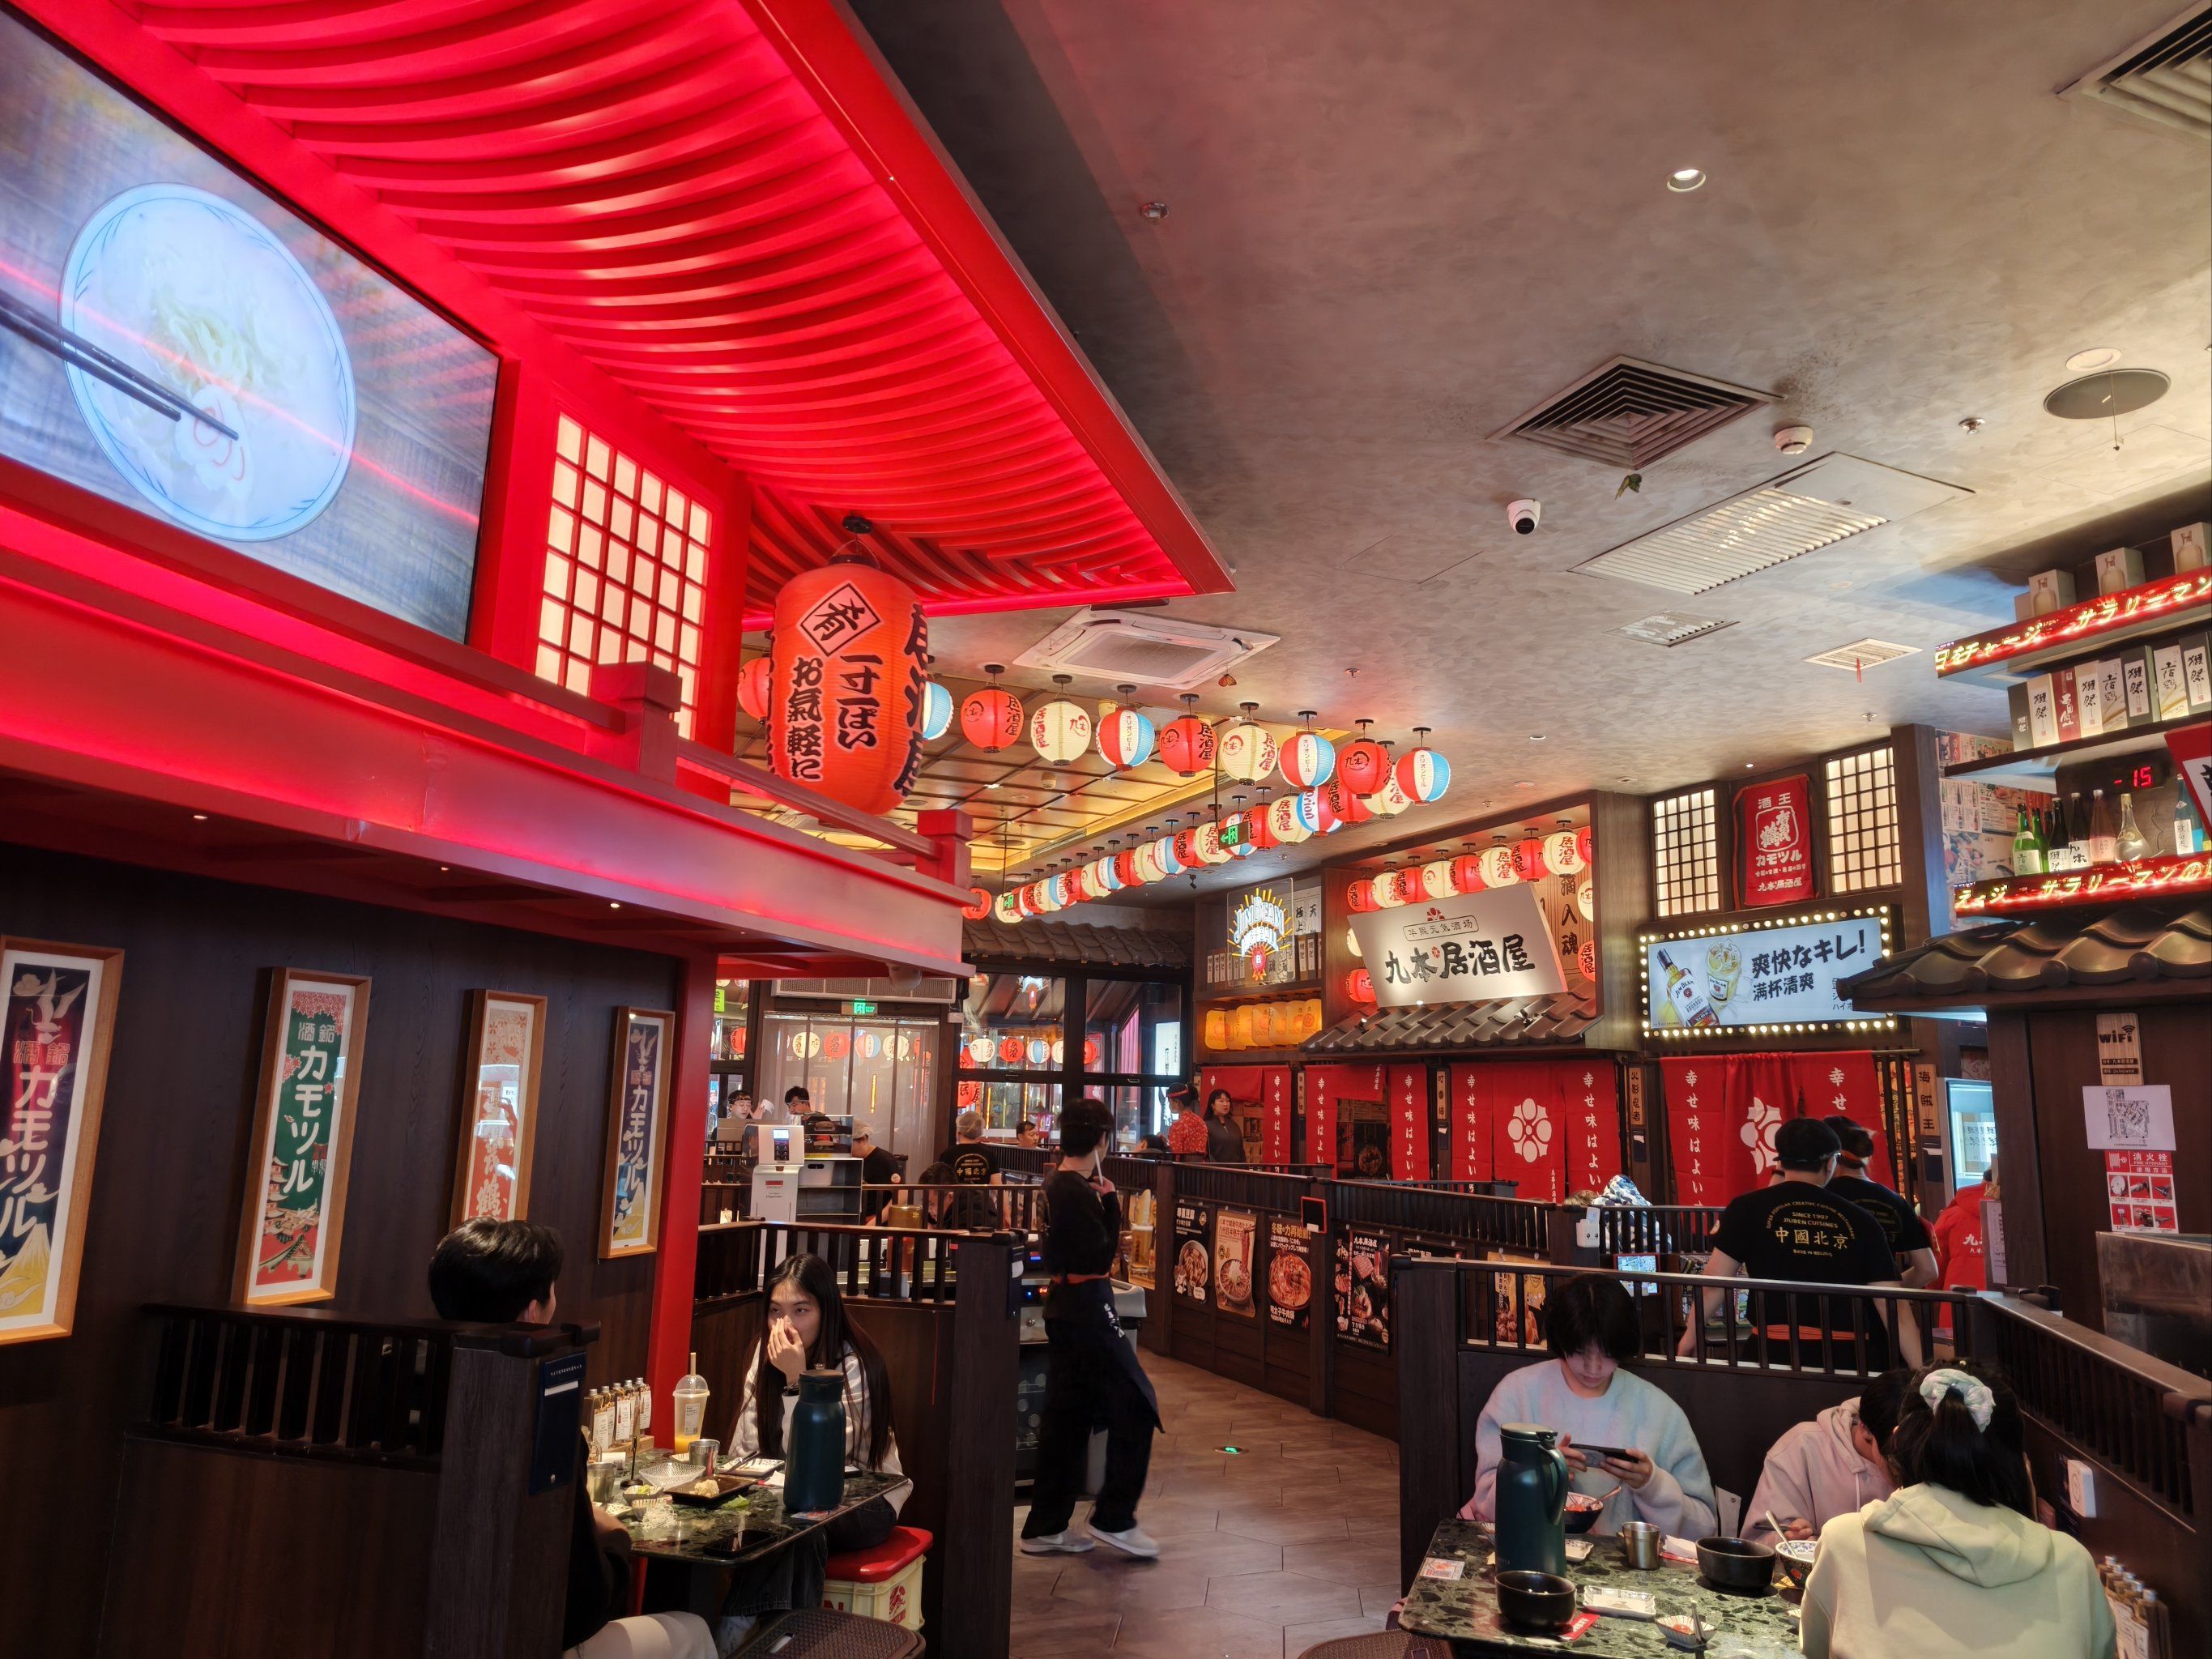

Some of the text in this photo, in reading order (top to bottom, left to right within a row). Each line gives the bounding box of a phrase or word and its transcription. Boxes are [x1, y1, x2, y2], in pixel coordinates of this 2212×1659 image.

[1259, 732, 1276, 770] 居酒屋
[1276, 800, 1294, 832] 居酒屋
[1558, 836, 1575, 865] 居酒屋
[1756, 849, 1802, 867] カモツル
[2042, 860, 2212, 899] サラリーマンの
[1384, 932, 1536, 987] 九本居酒屋
[1631, 1071, 1641, 1122] 火影忍者
[283, 1045, 328, 1193] カモツル
[624, 1085, 649, 1191] カモツル
[1685, 1069, 1704, 1206] 幸せ味はよい
[0, 1064, 58, 1238] カモツル
[2133, 1152, 2168, 1162] 消火栓
[1775, 1226, 1849, 1249] 中國北京
